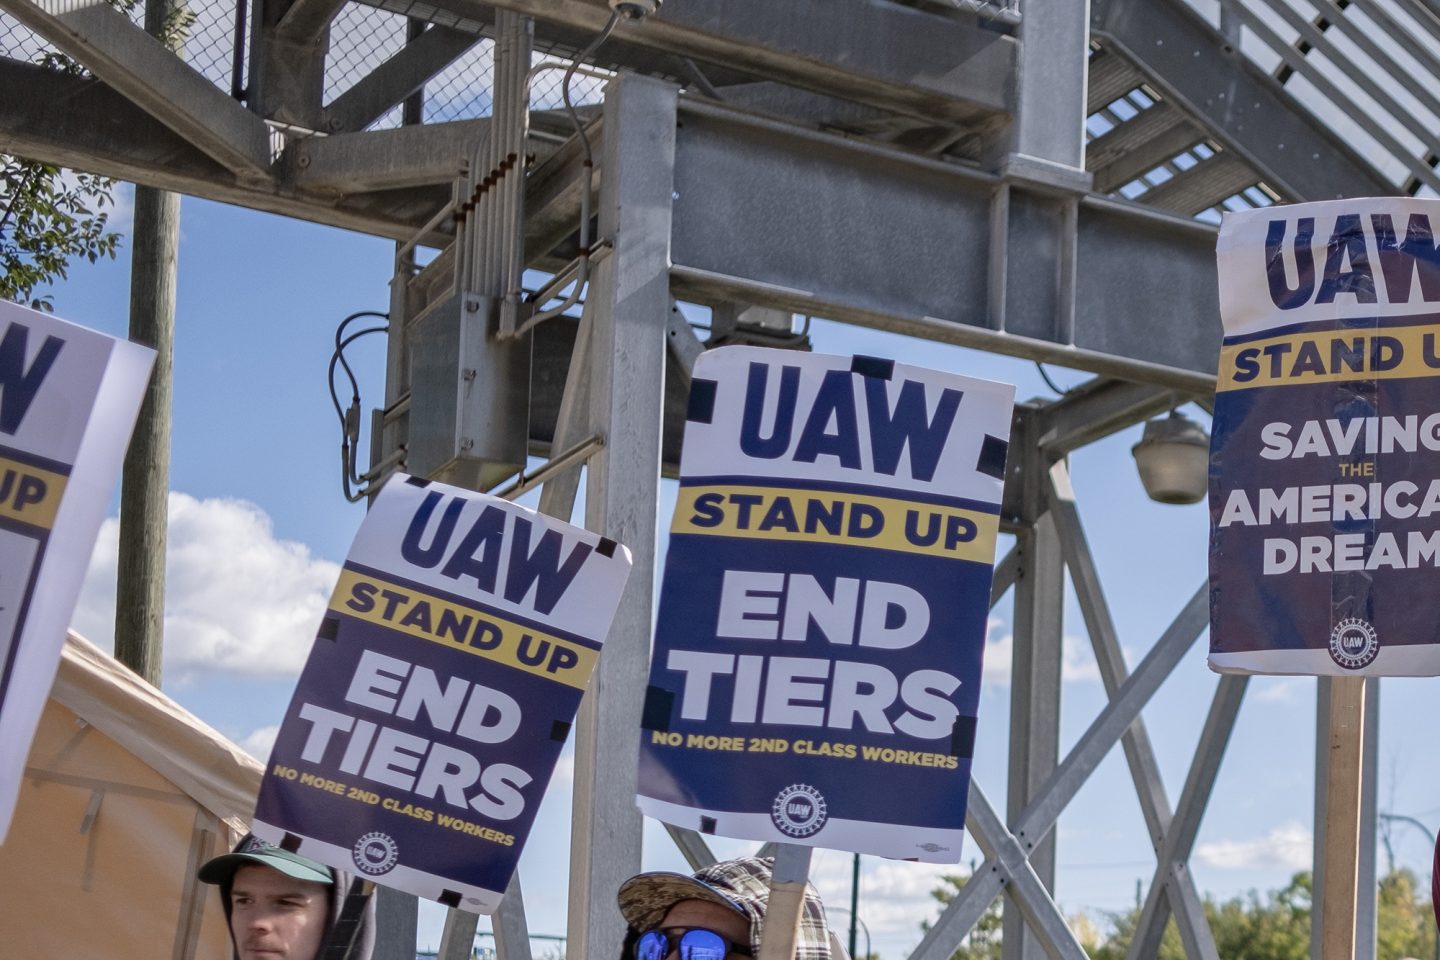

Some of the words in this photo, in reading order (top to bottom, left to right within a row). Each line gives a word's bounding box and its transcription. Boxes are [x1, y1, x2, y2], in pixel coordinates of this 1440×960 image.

[1232, 336, 1404, 383] STAND
[739, 361, 964, 482] UAW
[1339, 462, 1375, 478] THE
[401, 490, 593, 615] UAW
[689, 493, 885, 539] STAND
[903, 510, 978, 550] UP
[345, 581, 502, 658] STAND
[515, 632, 579, 675] UP
[716, 569, 930, 649] END
[1343, 636, 1364, 648] UAW
[345, 649, 521, 744] END
[667, 649, 962, 739] TIERS
[298, 702, 533, 820] TIERS
[652, 730, 682, 747] NO
[687, 734, 745, 752] MORE
[748, 738, 789, 753] 2ND
[793, 740, 857, 758] CLASS
[862, 746, 958, 769] WORKERS
[273, 764, 298, 780] NO
[300, 773, 346, 796] MORE
[346, 787, 381, 805] 2ND
[382, 798, 434, 822] CLASS
[437, 813, 515, 846] WORKERS
